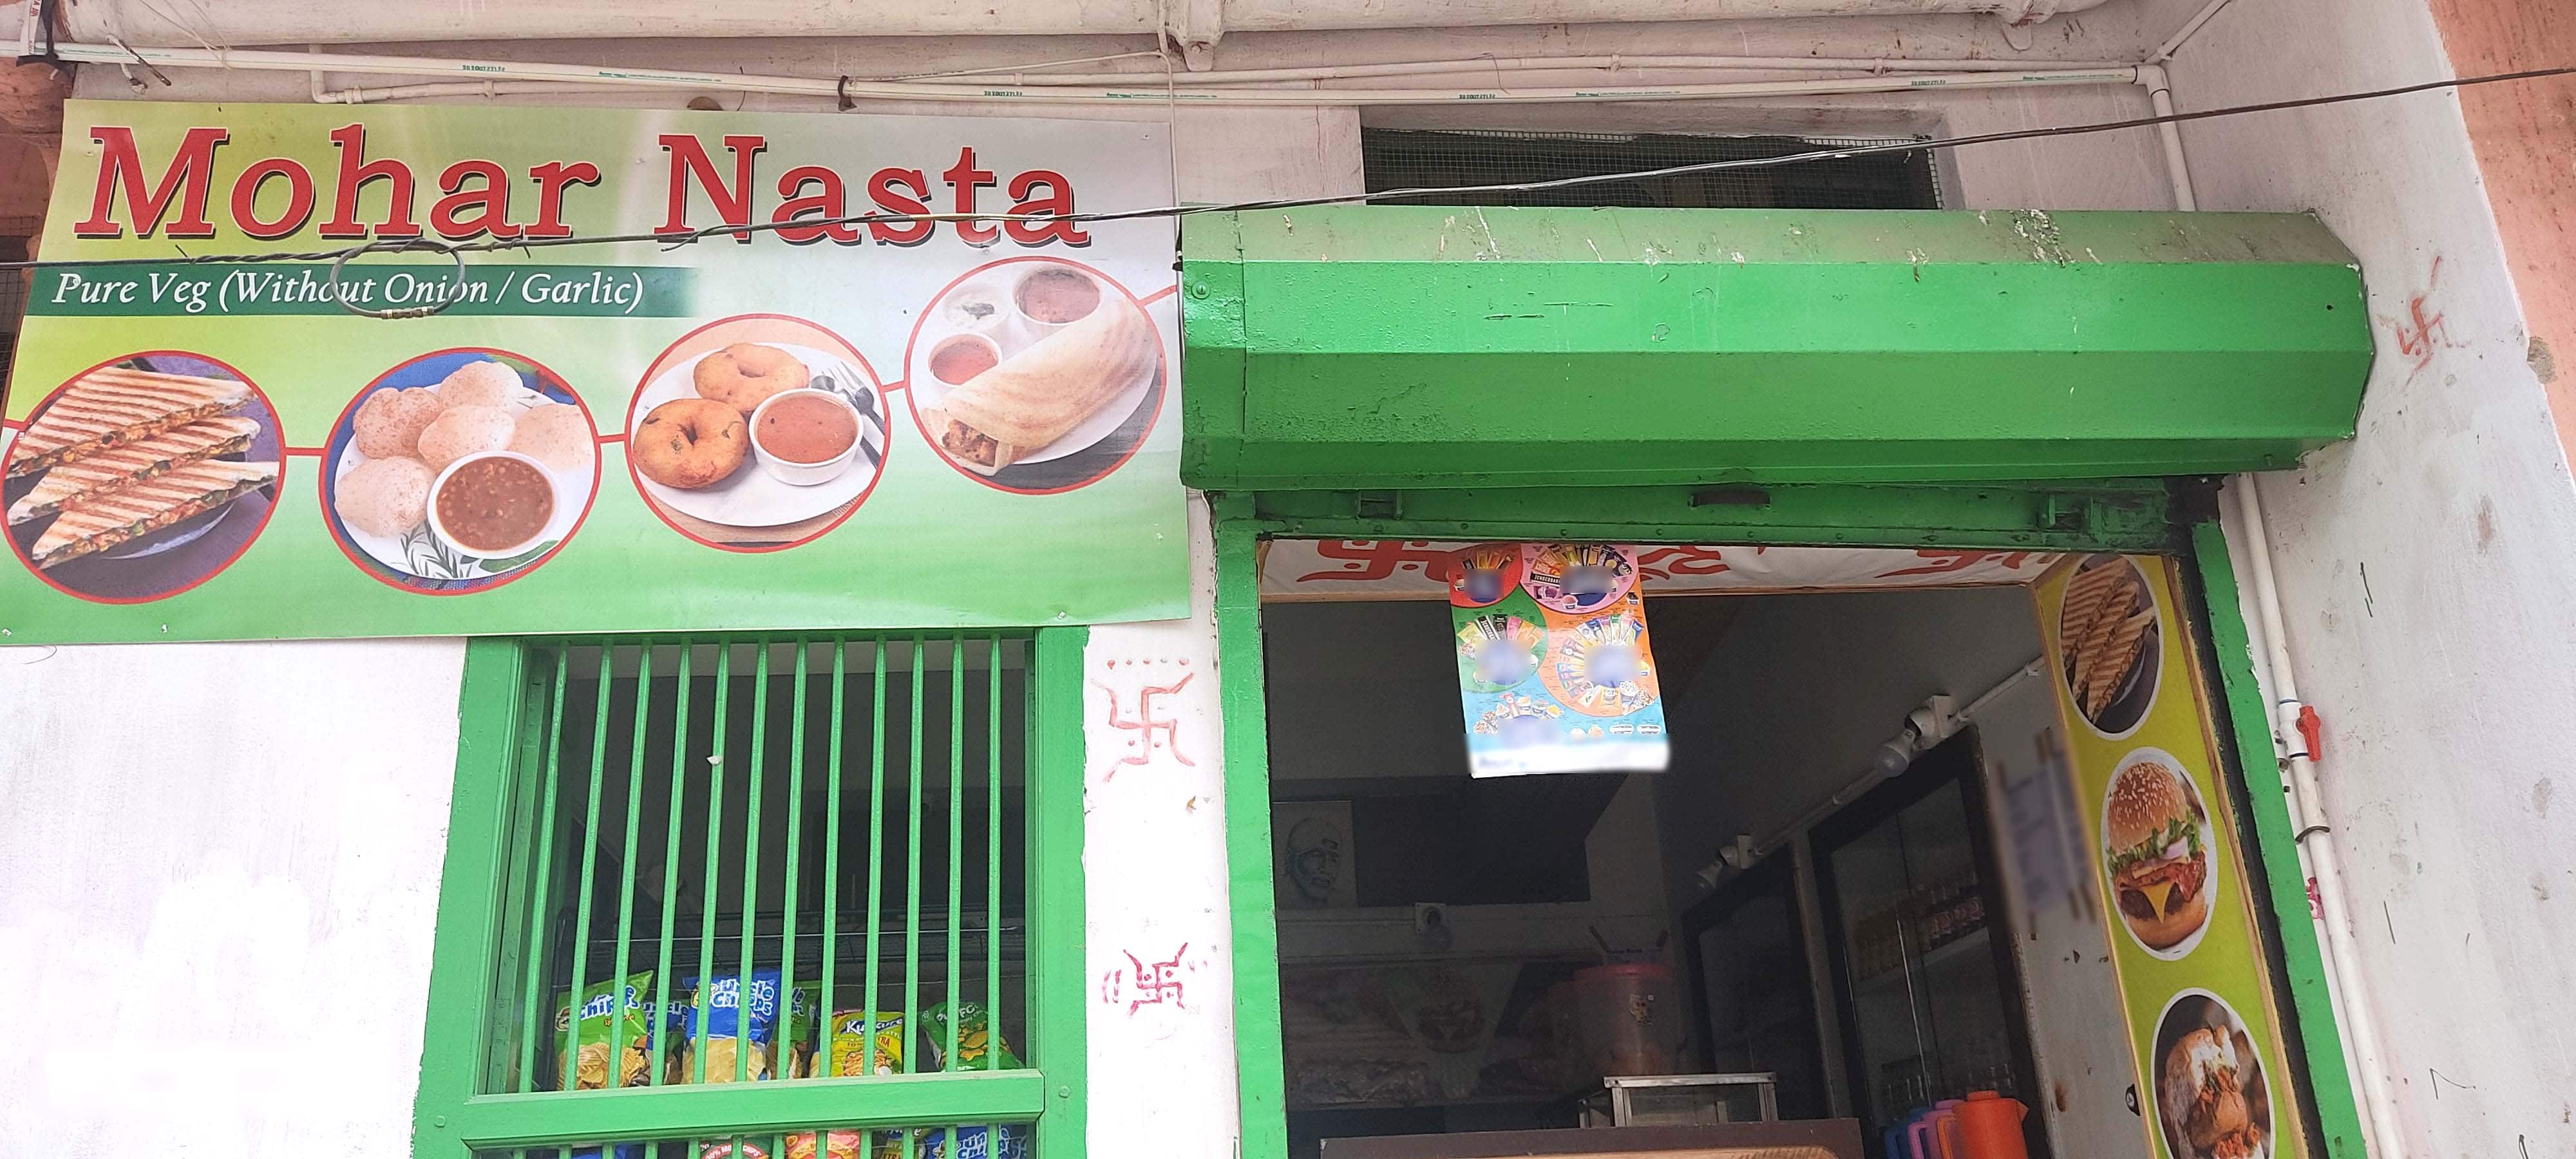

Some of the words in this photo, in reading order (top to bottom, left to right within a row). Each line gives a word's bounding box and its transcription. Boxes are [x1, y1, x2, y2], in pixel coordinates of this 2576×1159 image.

[73, 123, 601, 241] Mohar
[654, 134, 1092, 247] Nasta
[51, 272, 138, 304] Pure
[149, 272, 211, 314] Veg
[219, 269, 377, 314] (Without
[384, 273, 488, 303] Onion
[495, 270, 515, 305] /
[522, 270, 643, 314] Garlic)
